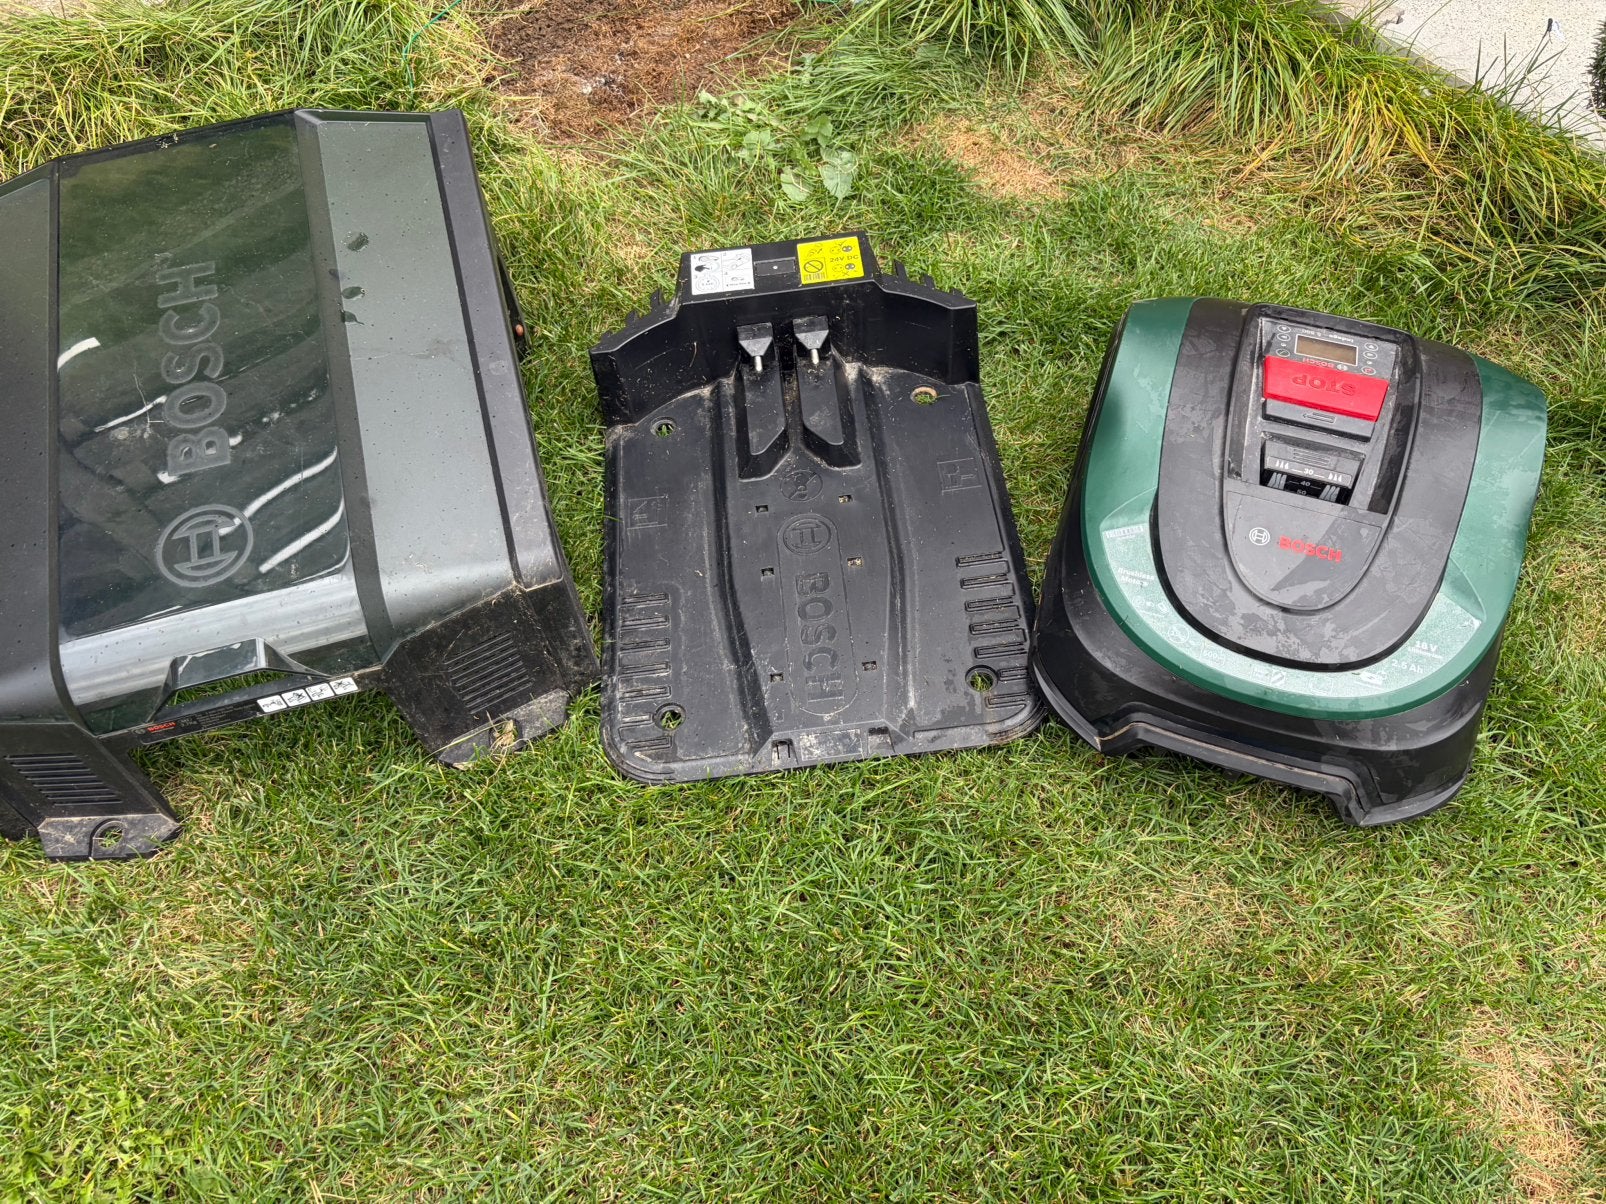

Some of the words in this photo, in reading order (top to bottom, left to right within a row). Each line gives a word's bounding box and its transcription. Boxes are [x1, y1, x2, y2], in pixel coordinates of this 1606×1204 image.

[155, 260, 231, 477] BOSCH
[1303, 357, 1335, 368] BOSCH
[1291, 374, 1357, 397] STOP
[1279, 534, 1343, 563] BOSCH
[795, 571, 845, 702] BOSCH
[1415, 639, 1428, 651] 18
[1428, 643, 1438, 652] V
[1391, 659, 1408, 670] 2.5
[1409, 664, 1424, 674] Ah
[147, 722, 176, 733] BOSCH
